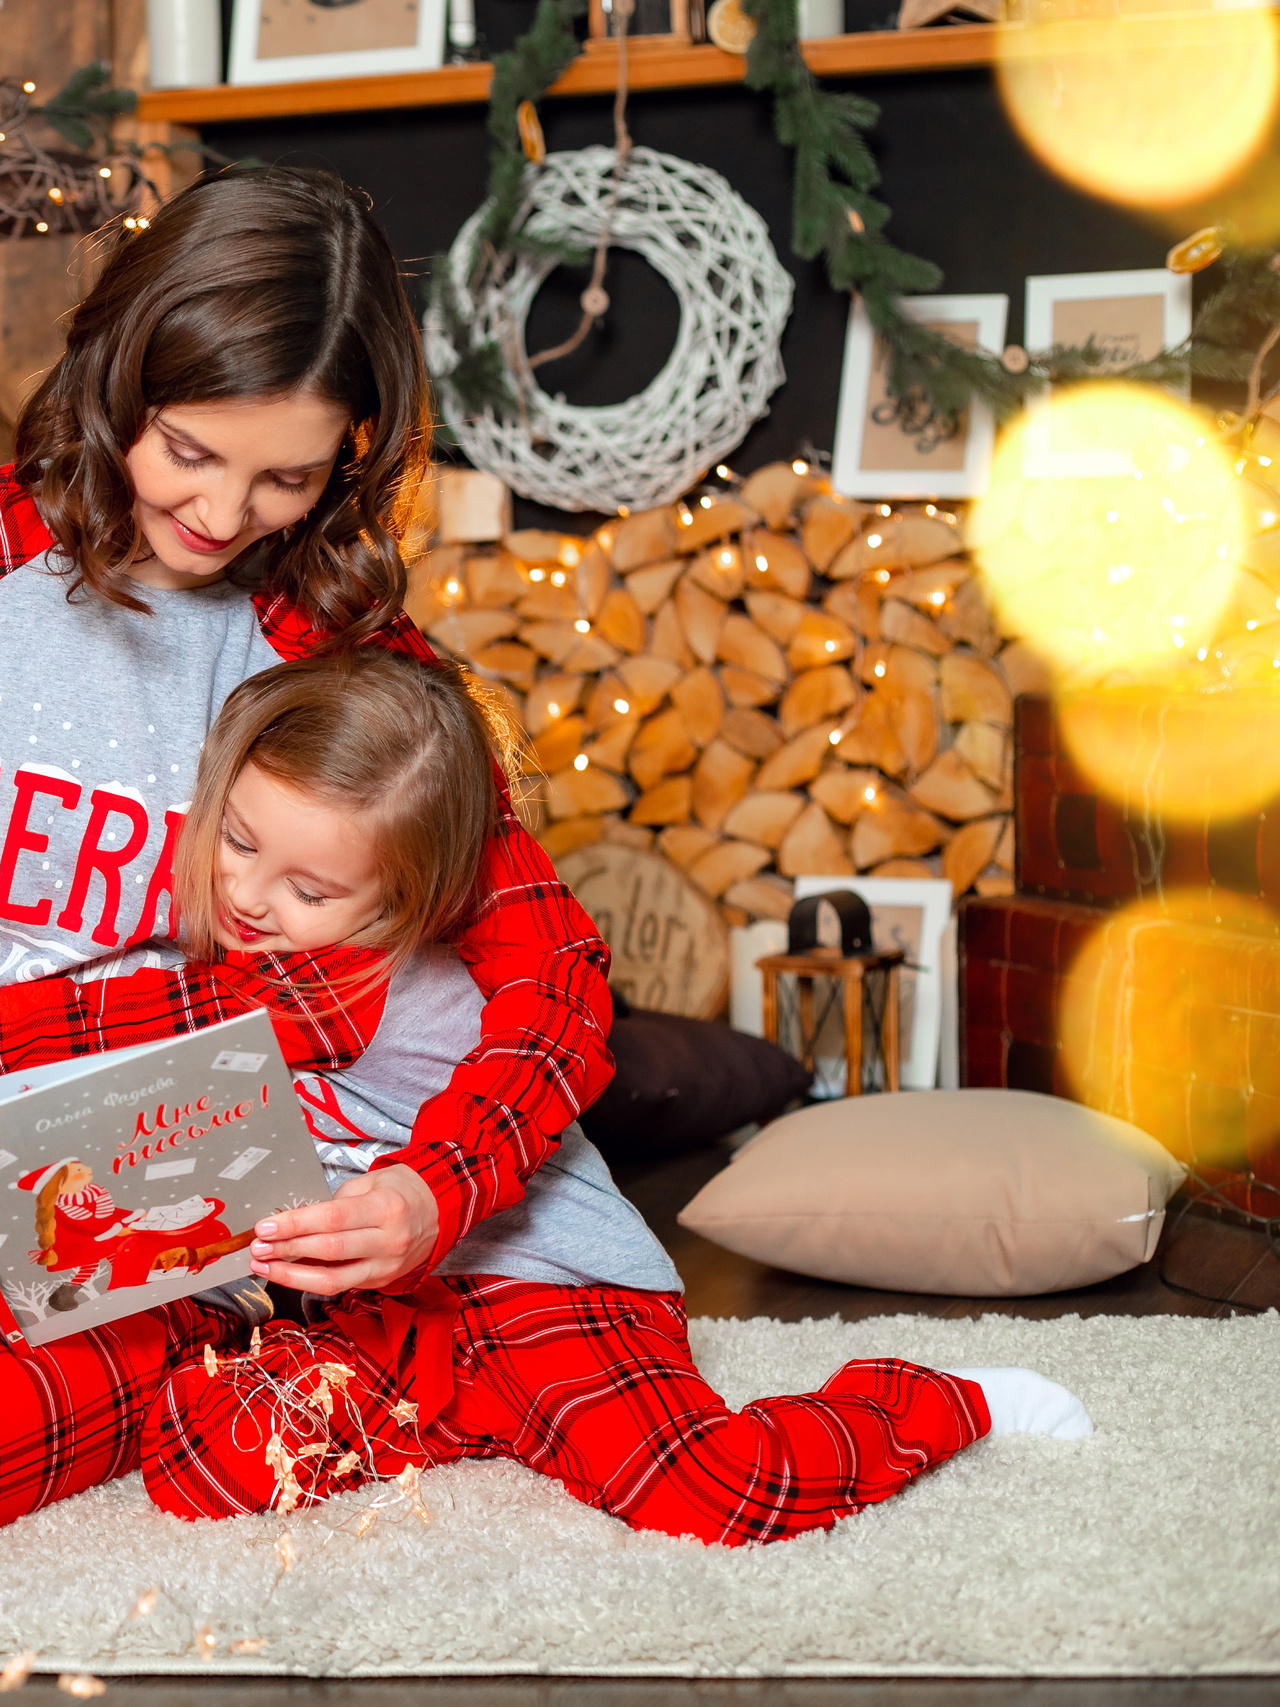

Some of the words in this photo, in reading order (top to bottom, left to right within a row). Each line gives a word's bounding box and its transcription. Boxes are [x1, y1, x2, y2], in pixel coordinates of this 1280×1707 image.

[35, 1105, 94, 1133] Ольга
[102, 1076, 176, 1107] Фадеева
[117, 1095, 217, 1149] Мне
